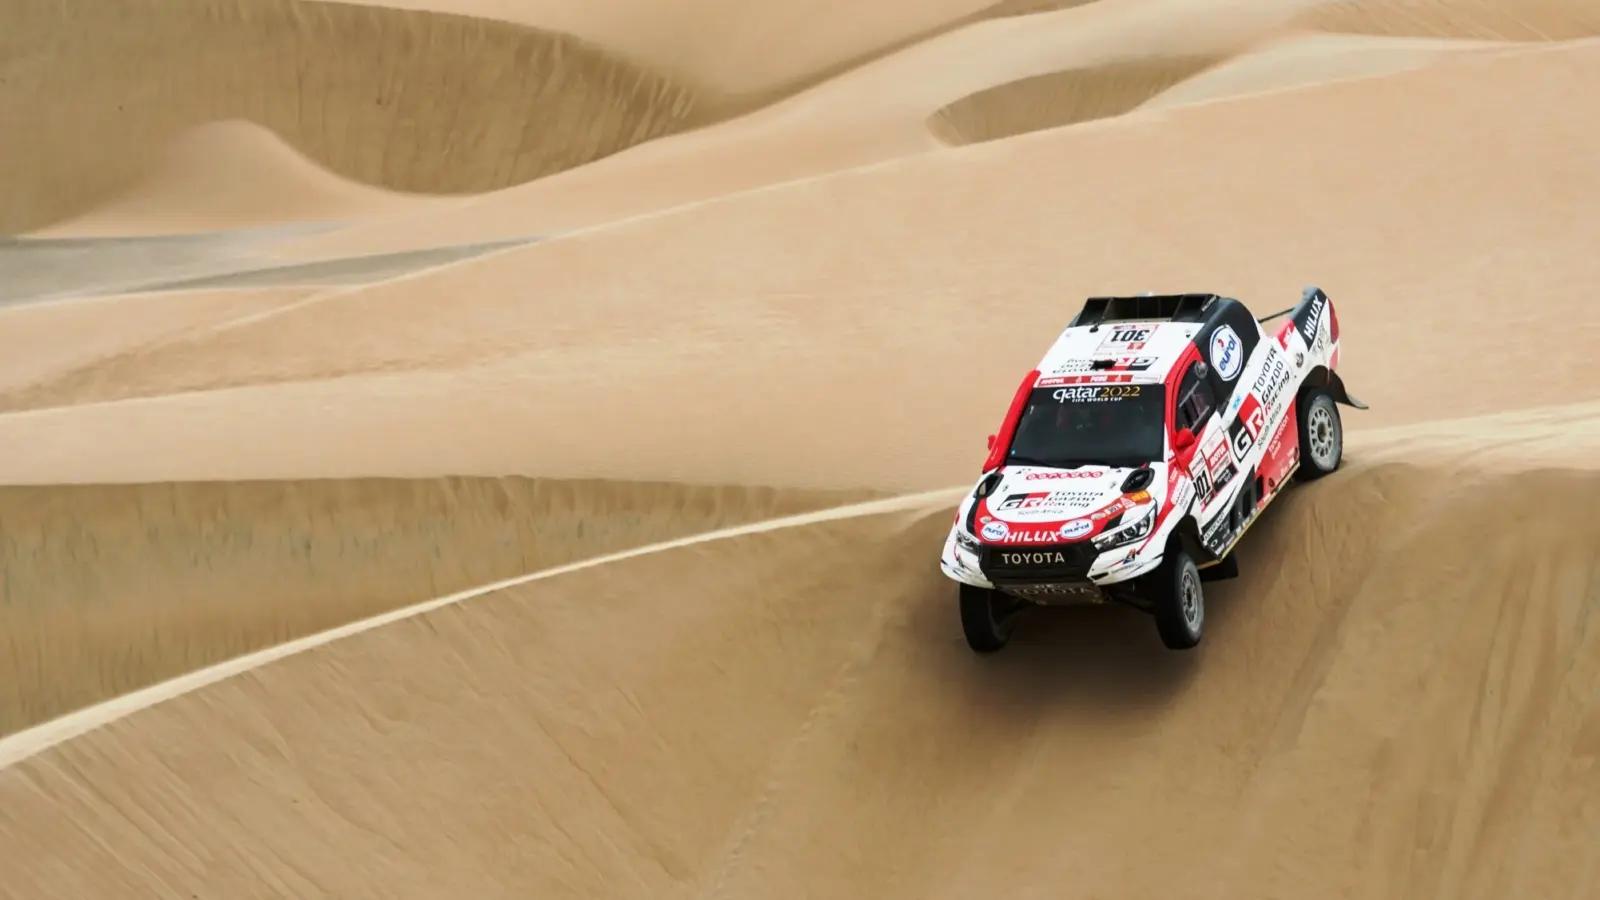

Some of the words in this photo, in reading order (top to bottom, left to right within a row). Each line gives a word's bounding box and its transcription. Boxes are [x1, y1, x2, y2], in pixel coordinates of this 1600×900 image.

[1111, 329, 1150, 342] 301
[1304, 295, 1323, 340] HILUX
[1219, 334, 1237, 372] eurol
[1252, 344, 1278, 393] TOYOTA
[1052, 387, 1101, 403] qatar
[1101, 386, 1140, 397] 2022
[1261, 360, 1284, 405] GAZOO
[1264, 370, 1290, 415] Racing
[1231, 402, 1264, 462] GR
[1193, 470, 1212, 501] 01
[1003, 530, 1061, 543] HILUX
[1001, 552, 1065, 565] TOYOTA
